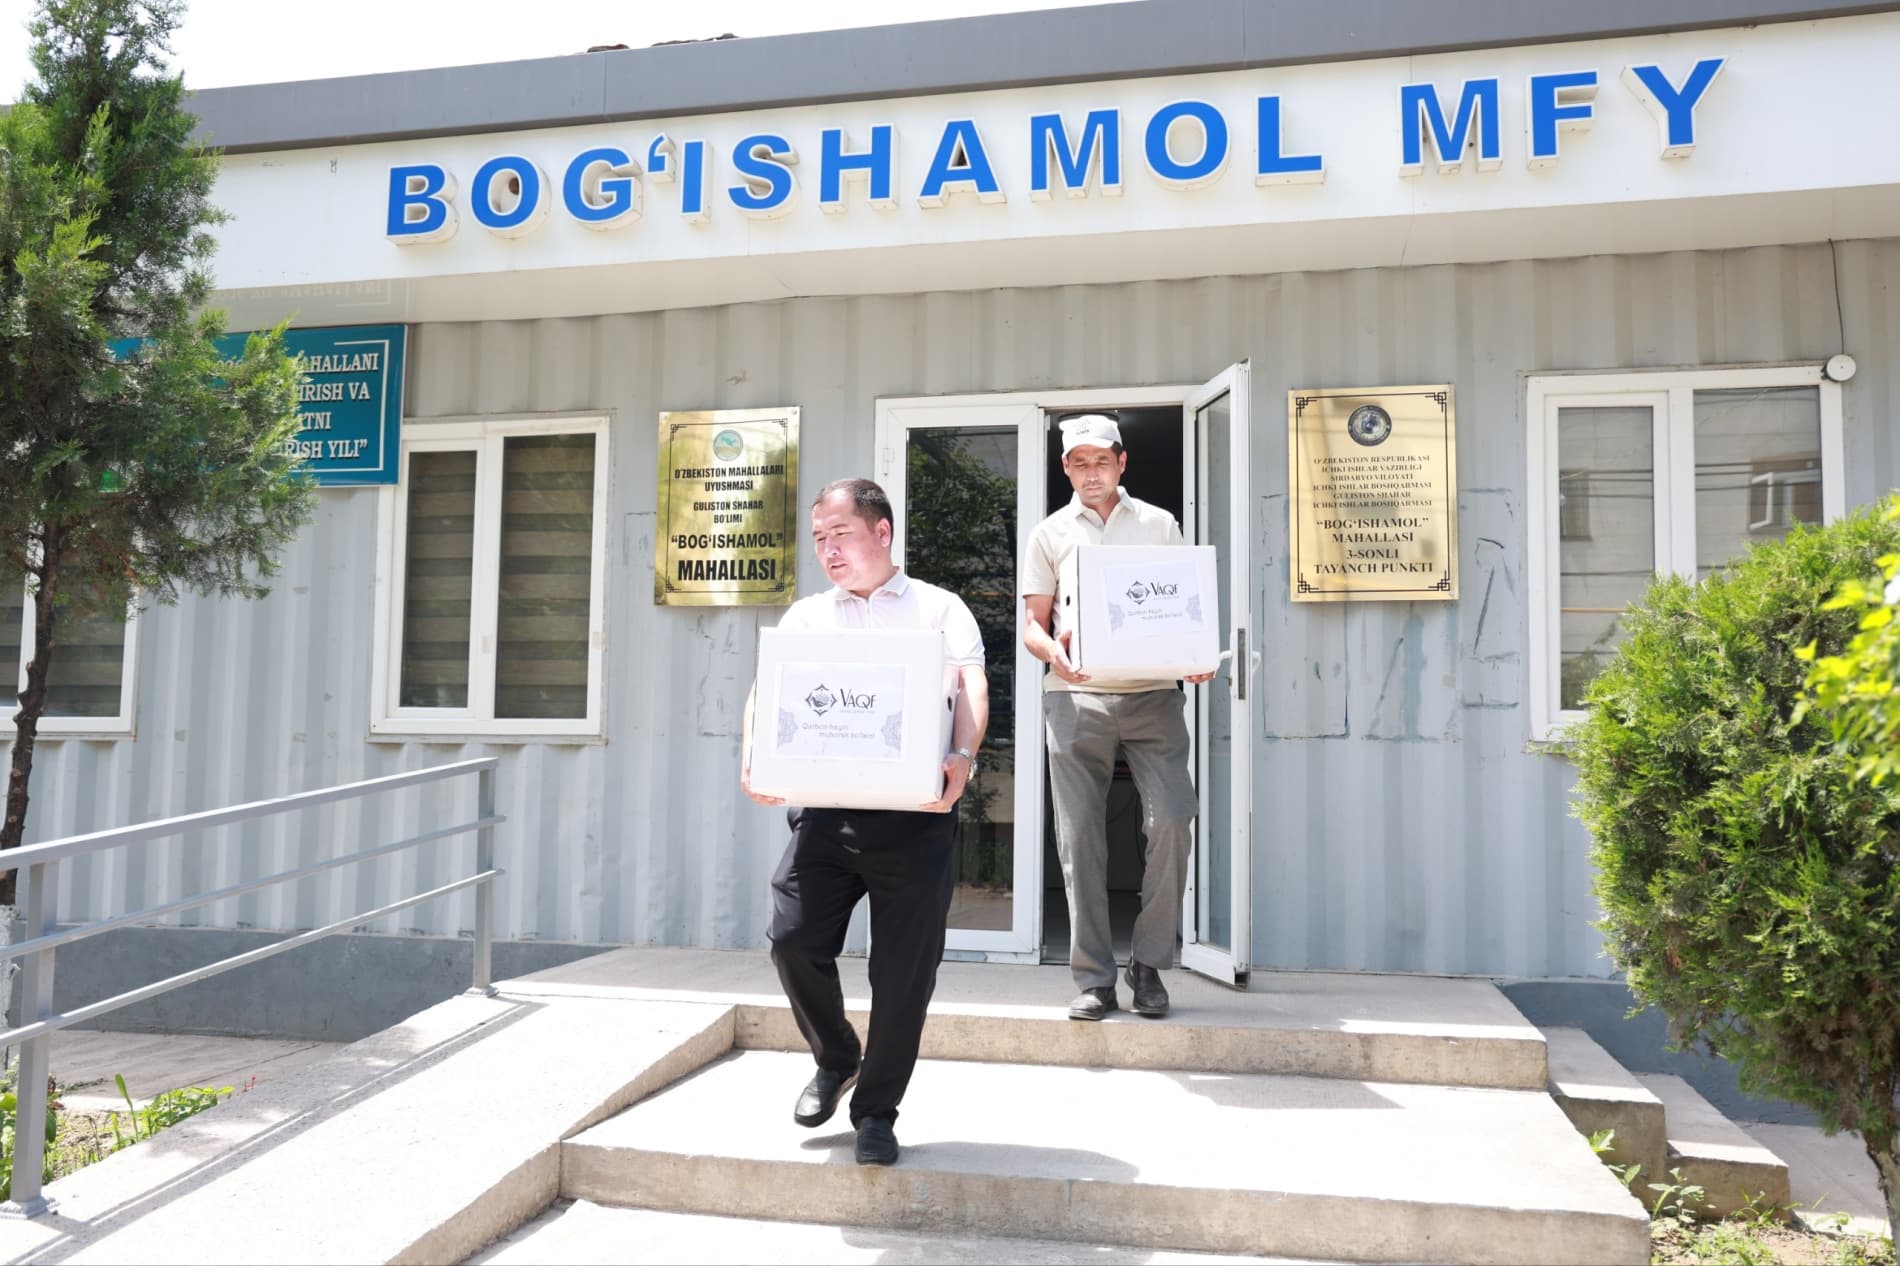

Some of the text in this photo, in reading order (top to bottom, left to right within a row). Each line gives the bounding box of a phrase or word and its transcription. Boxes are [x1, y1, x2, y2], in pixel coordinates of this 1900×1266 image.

[1399, 57, 1727, 170] MFY
[347, 382, 370, 400] VA
[728, 464, 785, 477] MAHALLALARI
[704, 480, 754, 491] UYUSHMASI
[693, 500, 764, 511] GULISTON SHAHAR
[1332, 532, 1414, 543] MAHALLASI
[1346, 548, 1399, 559] 3-SONLI
[678, 559, 776, 580] MAHALLASI
[1314, 562, 1433, 574] TAYANCH PUNKTI
[840, 688, 877, 709] VAQF
